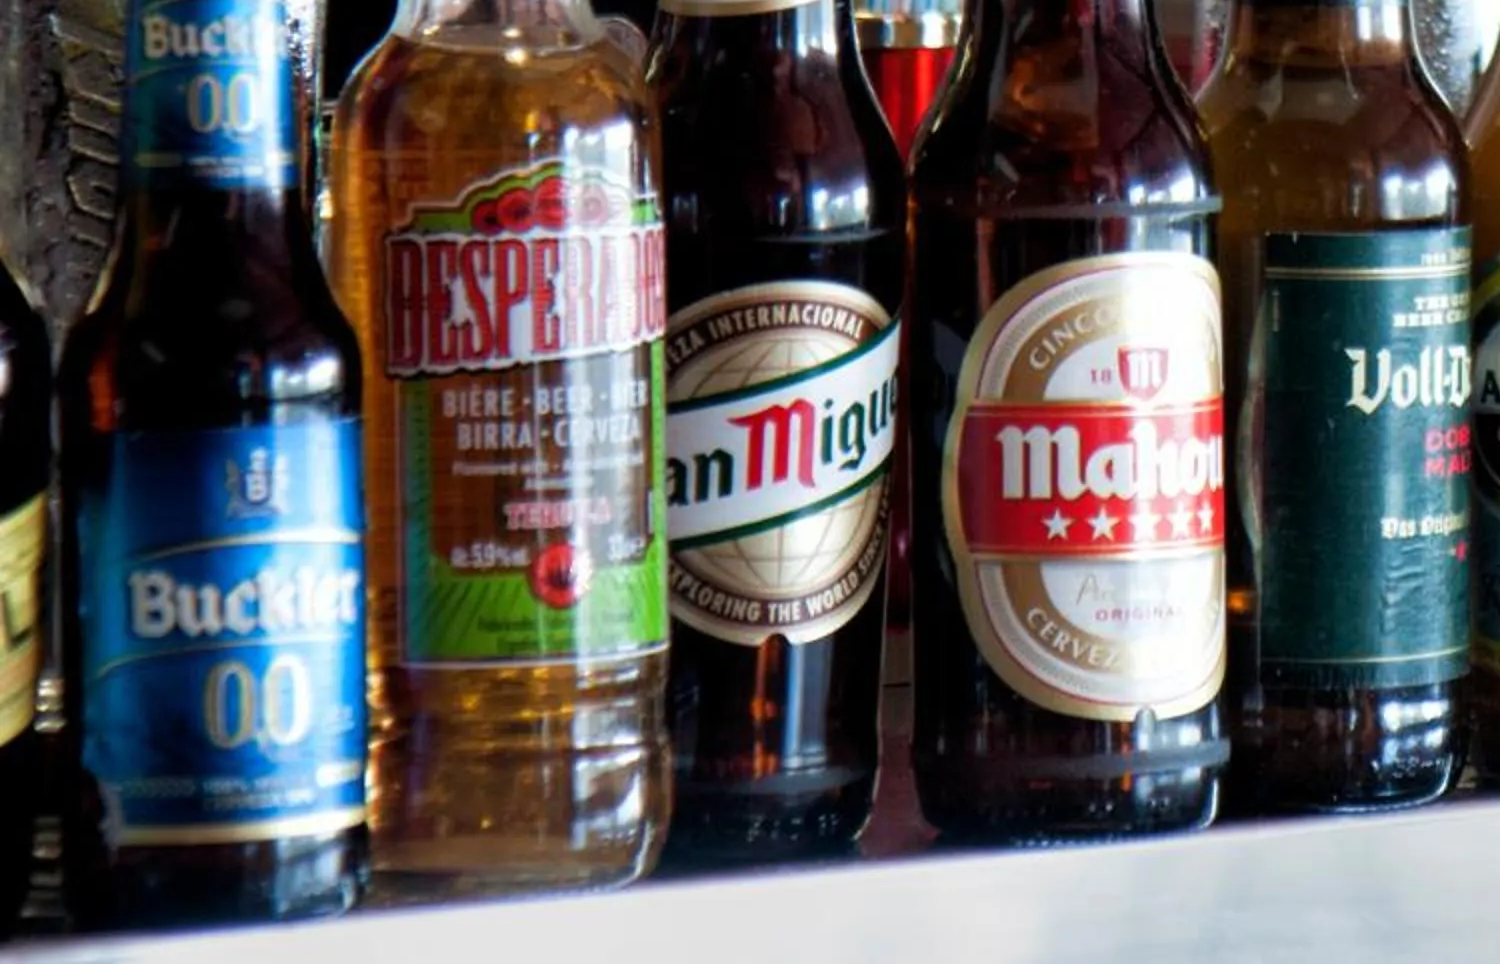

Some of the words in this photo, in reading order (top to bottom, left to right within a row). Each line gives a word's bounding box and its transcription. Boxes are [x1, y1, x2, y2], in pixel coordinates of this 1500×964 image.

[708, 302, 862, 339] INTERNACIONAL
[456, 420, 533, 450] BIRRA
[129, 564, 361, 638] Buckler
[767, 603, 801, 624] THE
[806, 571, 859, 618] WORLD
